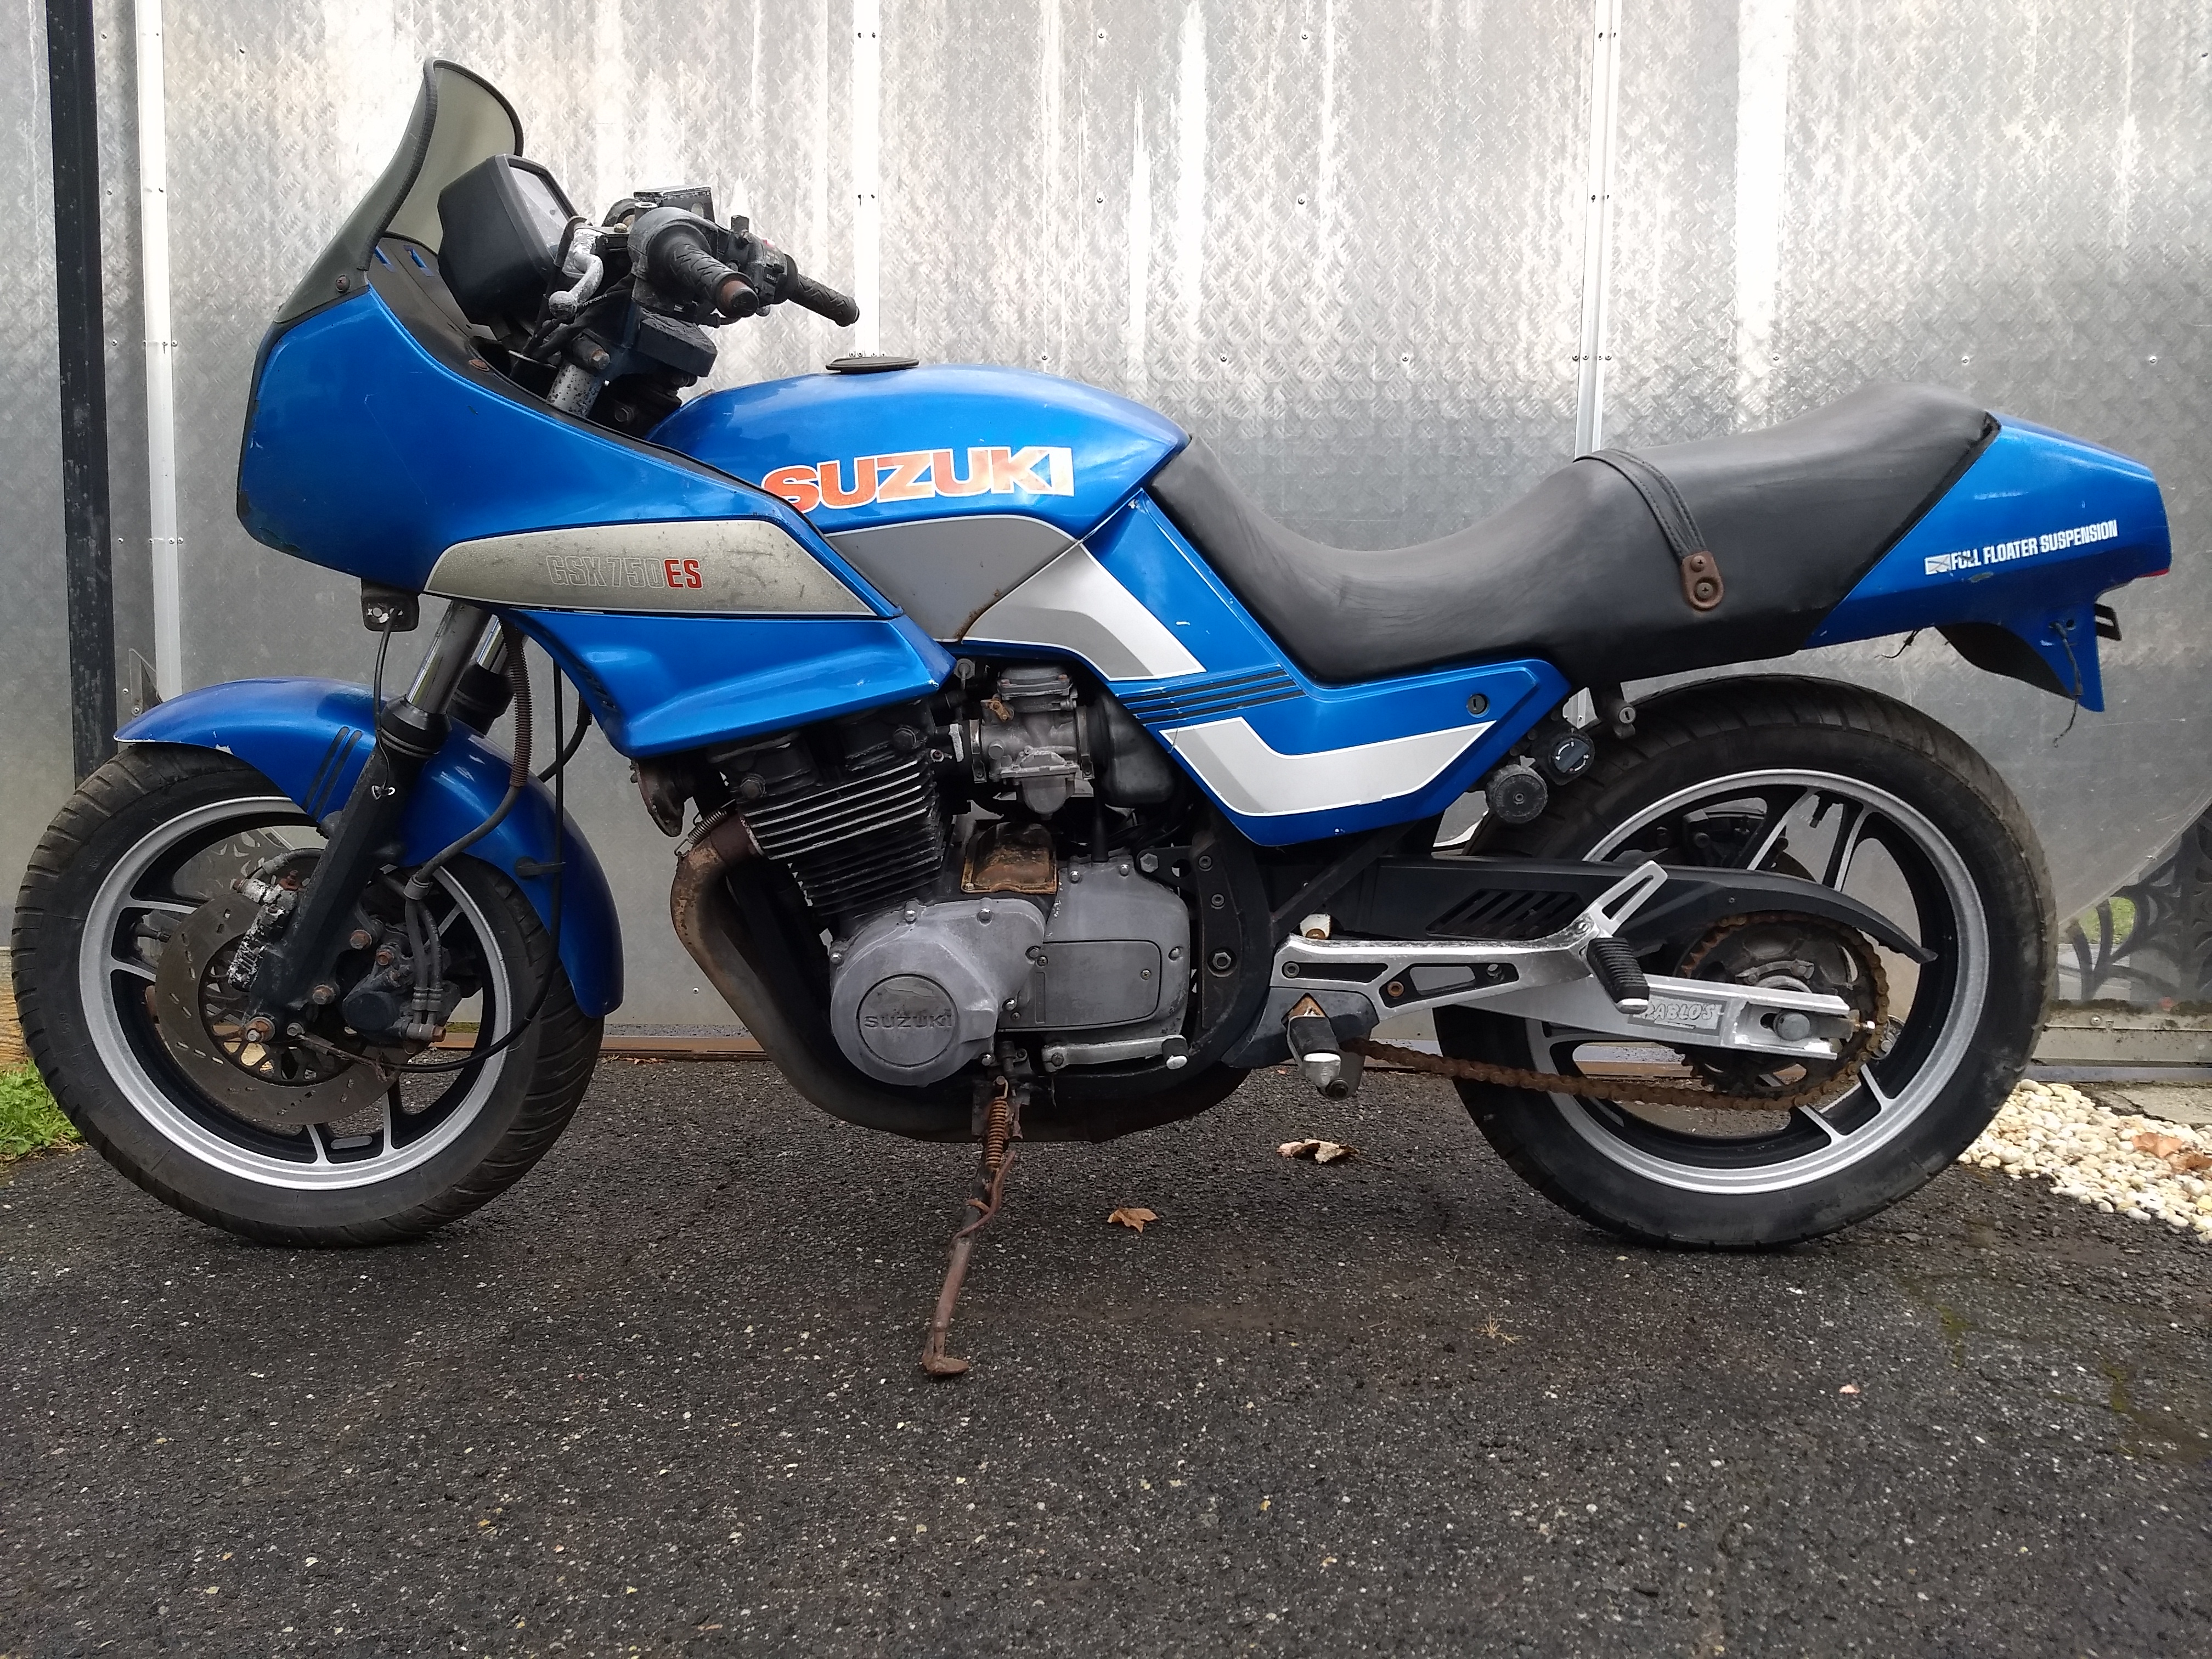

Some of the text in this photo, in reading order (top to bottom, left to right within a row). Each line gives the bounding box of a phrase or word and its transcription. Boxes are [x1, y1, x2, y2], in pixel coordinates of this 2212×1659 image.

[761, 445, 1074, 514] SUZUKI
[1951, 519, 2118, 571] FULL FLOATER SUSPENSION
[864, 1015, 952, 1029] SUZUKI
